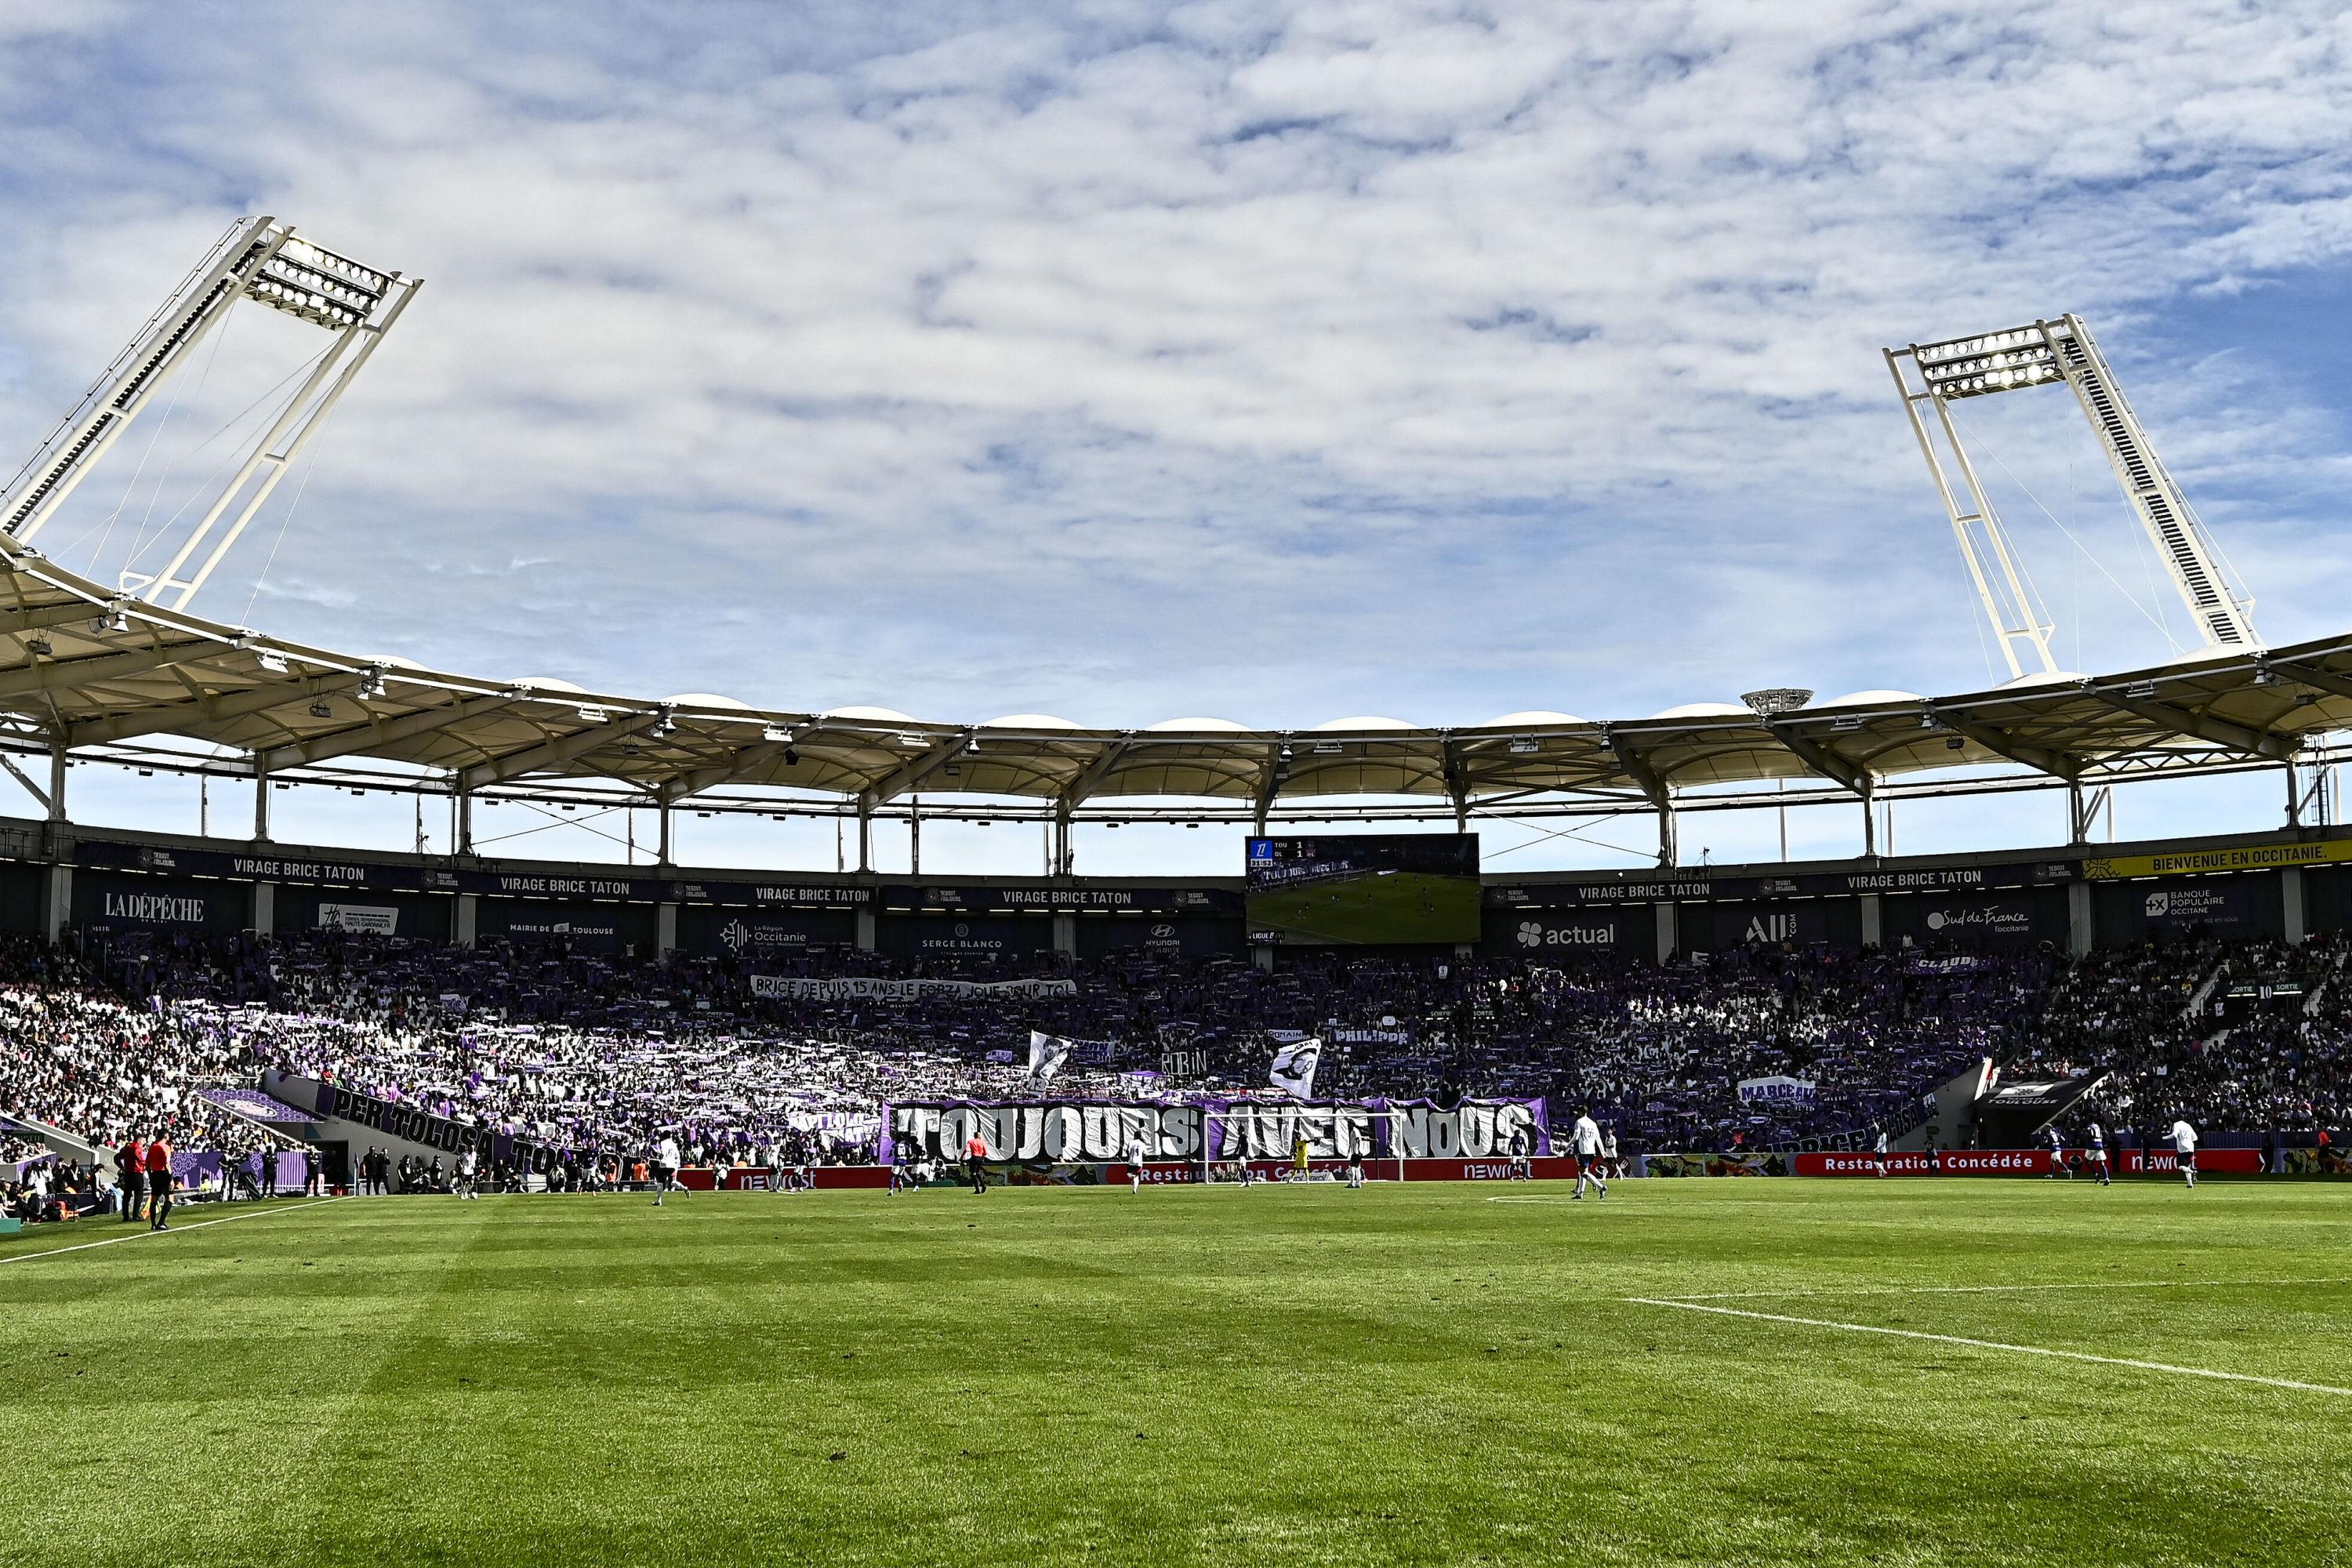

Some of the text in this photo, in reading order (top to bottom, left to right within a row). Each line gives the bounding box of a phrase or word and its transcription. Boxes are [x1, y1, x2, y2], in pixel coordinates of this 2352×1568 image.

[2153, 845, 2328, 871] BIENVENUE EN OCCITANIE.
[234, 858, 365, 880] VIRAGE BRICE TATON
[501, 877, 630, 895] VIRAGE BRICE TATON
[1847, 870, 1982, 888] VIRAGE BRICE TATON
[756, 887, 870, 902] VIRAGE BRICE TATON
[1004, 891, 1132, 904] VIRAGE BRICE TATON
[1579, 883, 1711, 899] VIRAGE BRICE TATON
[2171, 890, 2211, 899] BANQUE
[105, 892, 204, 922] LA DÉPÊCHE
[2171, 896, 2225, 907] POPULAIRE
[1943, 906, 2029, 926] Sud de France
[2171, 907, 2209, 916] OCCITANE
[754, 931, 807, 942] Occitanie
[1546, 924, 1614, 944] actual
[756, 979, 797, 994] BRICE
[800, 981, 849, 996] DEPUIS
[853, 981, 867, 993] 15
[871, 982, 895, 995] ANS
[900, 983, 914, 996] LE
[2259, 985, 2272, 1000] 10
[1740, 1083, 1815, 1100] MARCEAU
[331, 1087, 384, 1131] PER
[390, 1105, 494, 1163] TOLOSA
[898, 1104, 1533, 1161] TOUJOURS AVEC NOUS
[1947, 1153, 2033, 1168] Concédée
